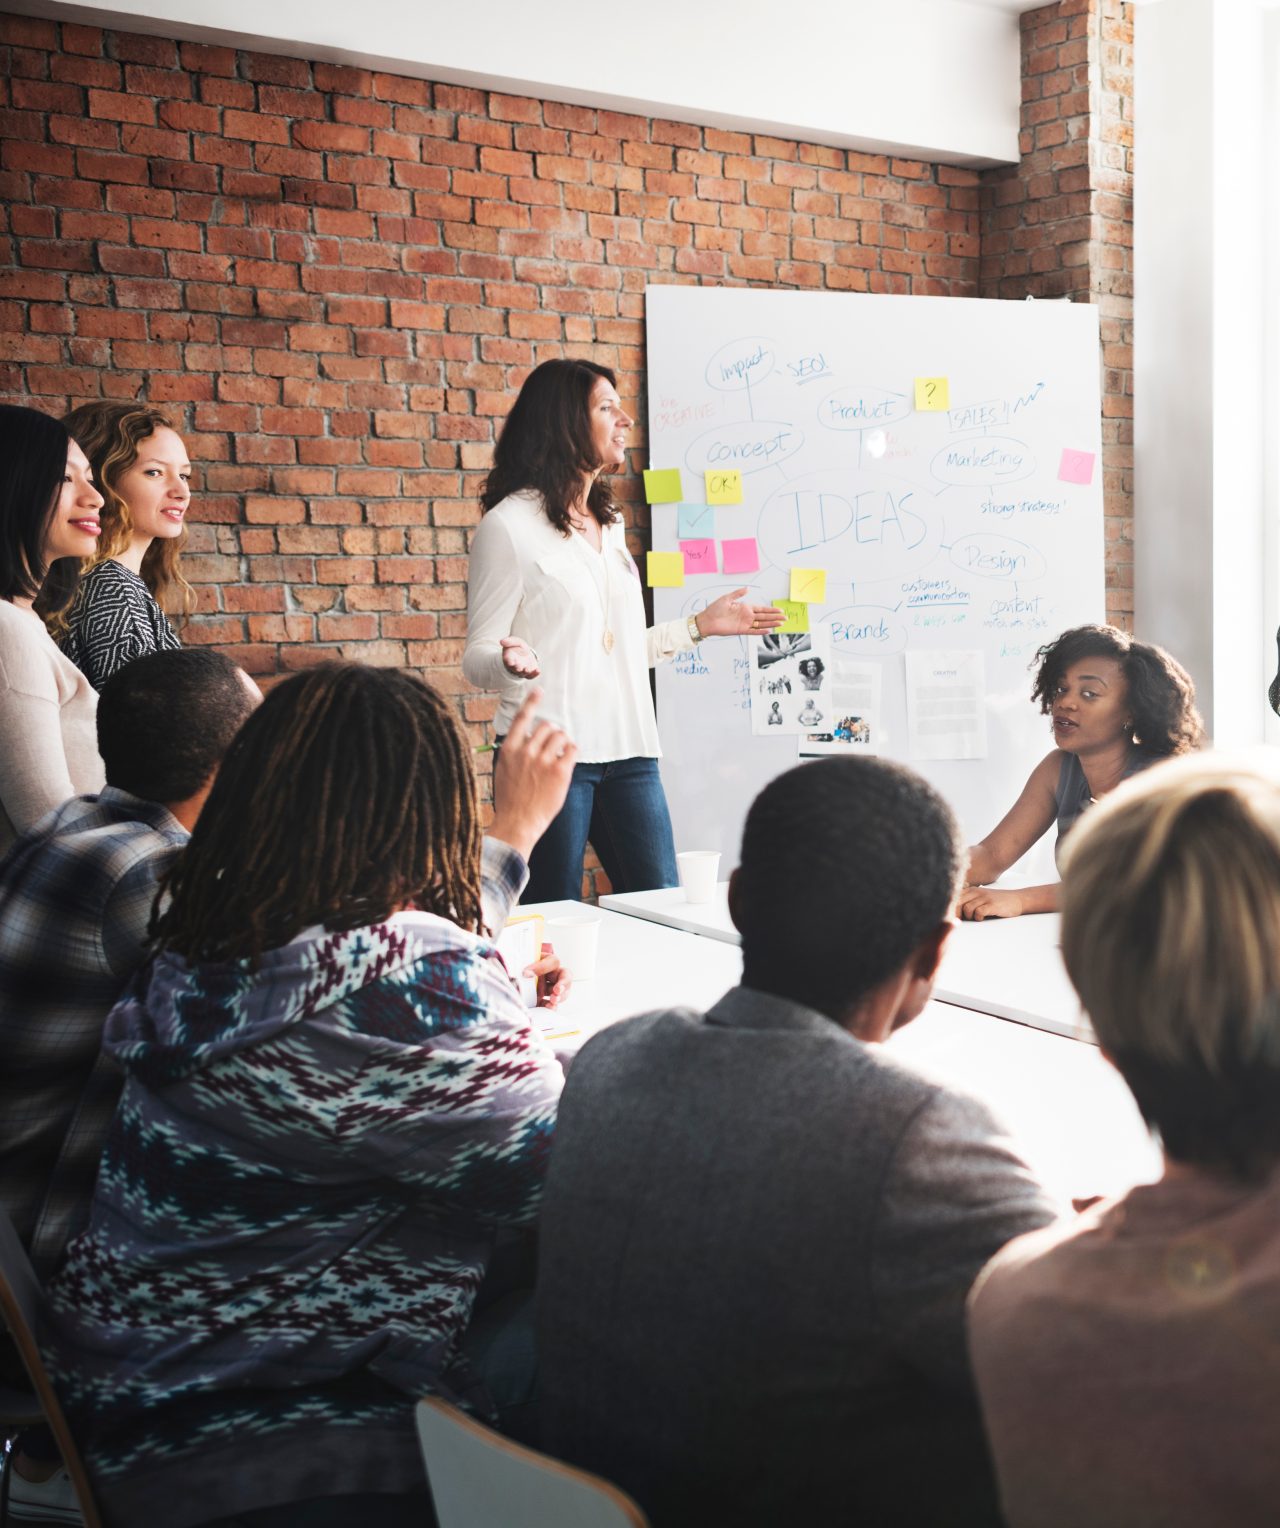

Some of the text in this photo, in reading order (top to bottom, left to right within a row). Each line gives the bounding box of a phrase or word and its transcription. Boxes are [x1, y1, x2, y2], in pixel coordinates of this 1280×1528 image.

[720, 345, 769, 382] Impact
[787, 352, 829, 377] SEO!
[924, 382, 937, 405] ?
[830, 399, 897, 421] Product
[946, 446, 1024, 476] Marketing
[710, 475, 737, 494] OK!
[980, 495, 1016, 520] strong
[777, 490, 928, 554] IDEAS
[686, 545, 708, 560] Yes!
[965, 544, 1027, 577] Design
[901, 576, 952, 593] customers
[831, 621, 890, 642] Brands
[675, 662, 710, 676] media
